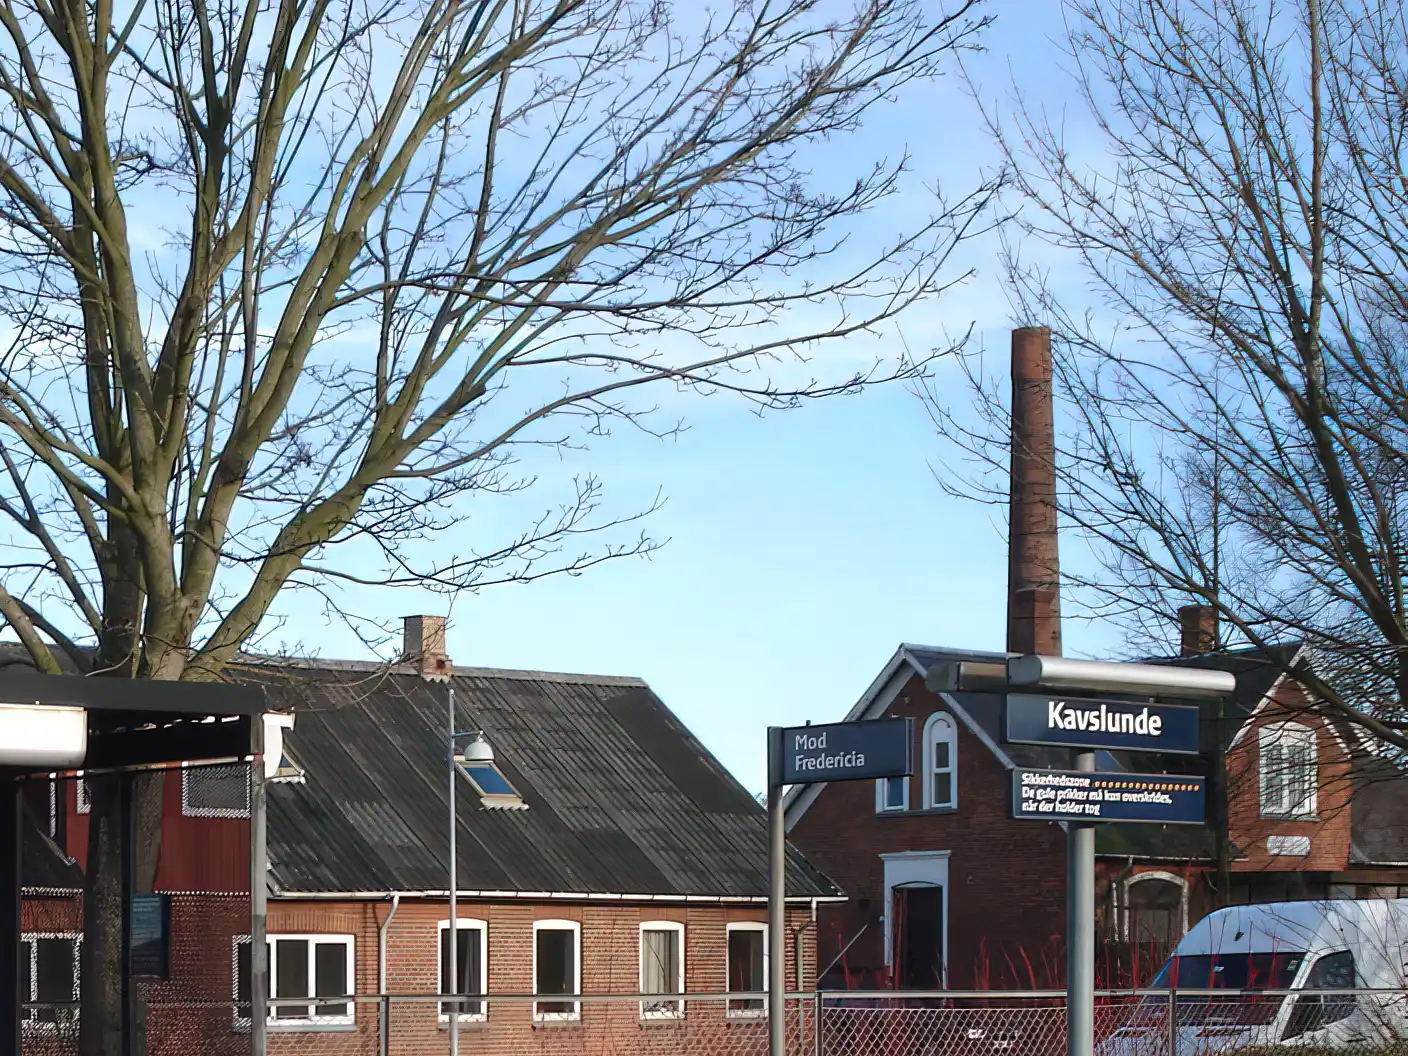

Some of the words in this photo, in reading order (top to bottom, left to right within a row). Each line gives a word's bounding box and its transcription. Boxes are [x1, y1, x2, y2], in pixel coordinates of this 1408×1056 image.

[1048, 700, 1163, 736] Kavslunde
[795, 731, 827, 751] Mod
[795, 750, 865, 772] Fredericia
[1021, 772, 1091, 788] Sikkerhedszone
[1022, 786, 1035, 799] De
[1085, 803, 1101, 816] tog
